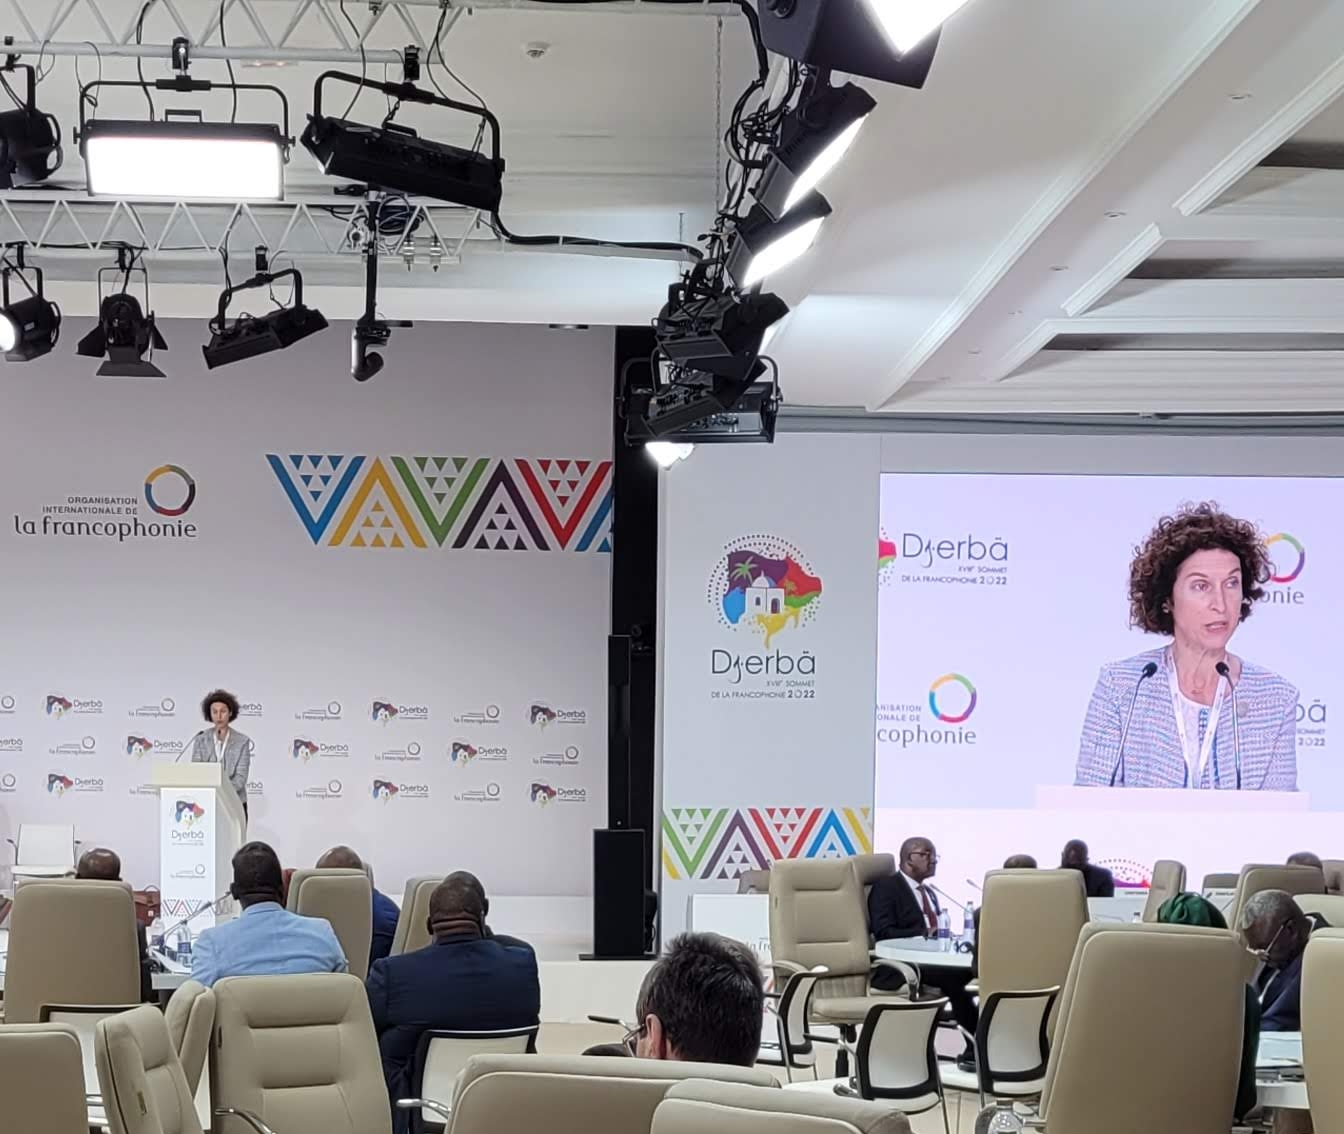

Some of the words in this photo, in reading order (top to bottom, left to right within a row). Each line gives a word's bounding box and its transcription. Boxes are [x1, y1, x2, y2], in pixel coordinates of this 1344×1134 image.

[67, 496, 138, 505] ORGANISATION
[42, 506, 123, 515] INTERNATIONALE
[125, 507, 138, 515] DE
[14, 515, 36, 535] la
[43, 515, 197, 541] francophonie
[902, 533, 1008, 568] Djerbä
[979, 575, 1007, 585] 2022
[1260, 586, 1305, 605] onie
[711, 648, 815, 684] Djerbä
[787, 690, 815, 699] 2022
